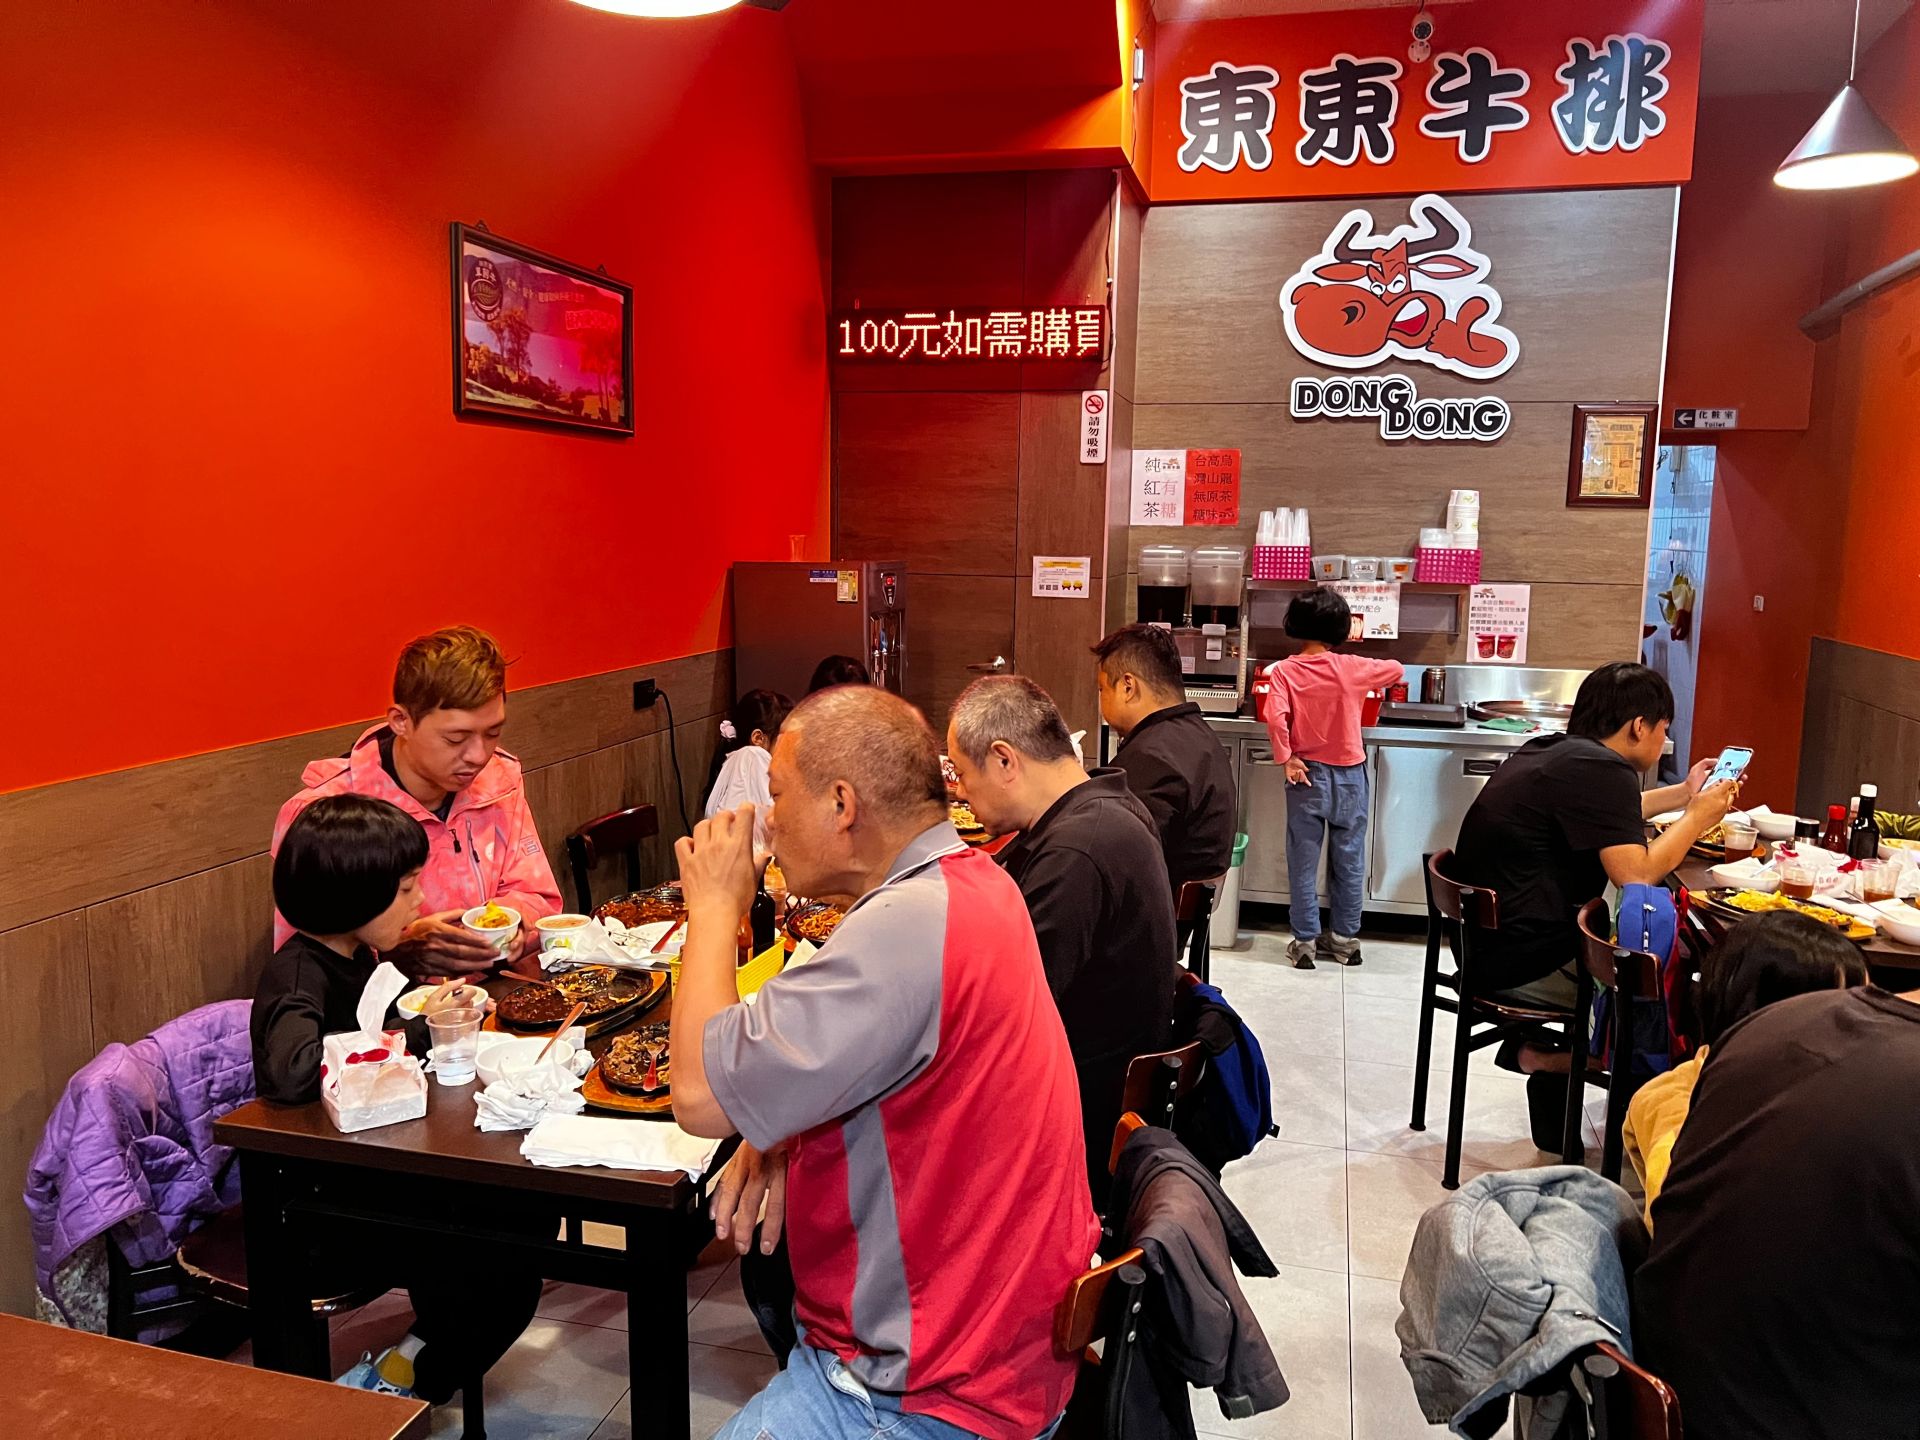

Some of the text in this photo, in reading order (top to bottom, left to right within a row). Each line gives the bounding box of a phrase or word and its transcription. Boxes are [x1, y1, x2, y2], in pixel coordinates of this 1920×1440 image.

[1179, 35, 1669, 170] 東東牛排
[1294, 377, 1412, 413] DONG
[1086, 416, 1100, 458] 請勿吸煙
[1384, 401, 1507, 436] DONG
[1143, 456, 1161, 519] 純紅茶
[1160, 479, 1178, 519] 有糖
